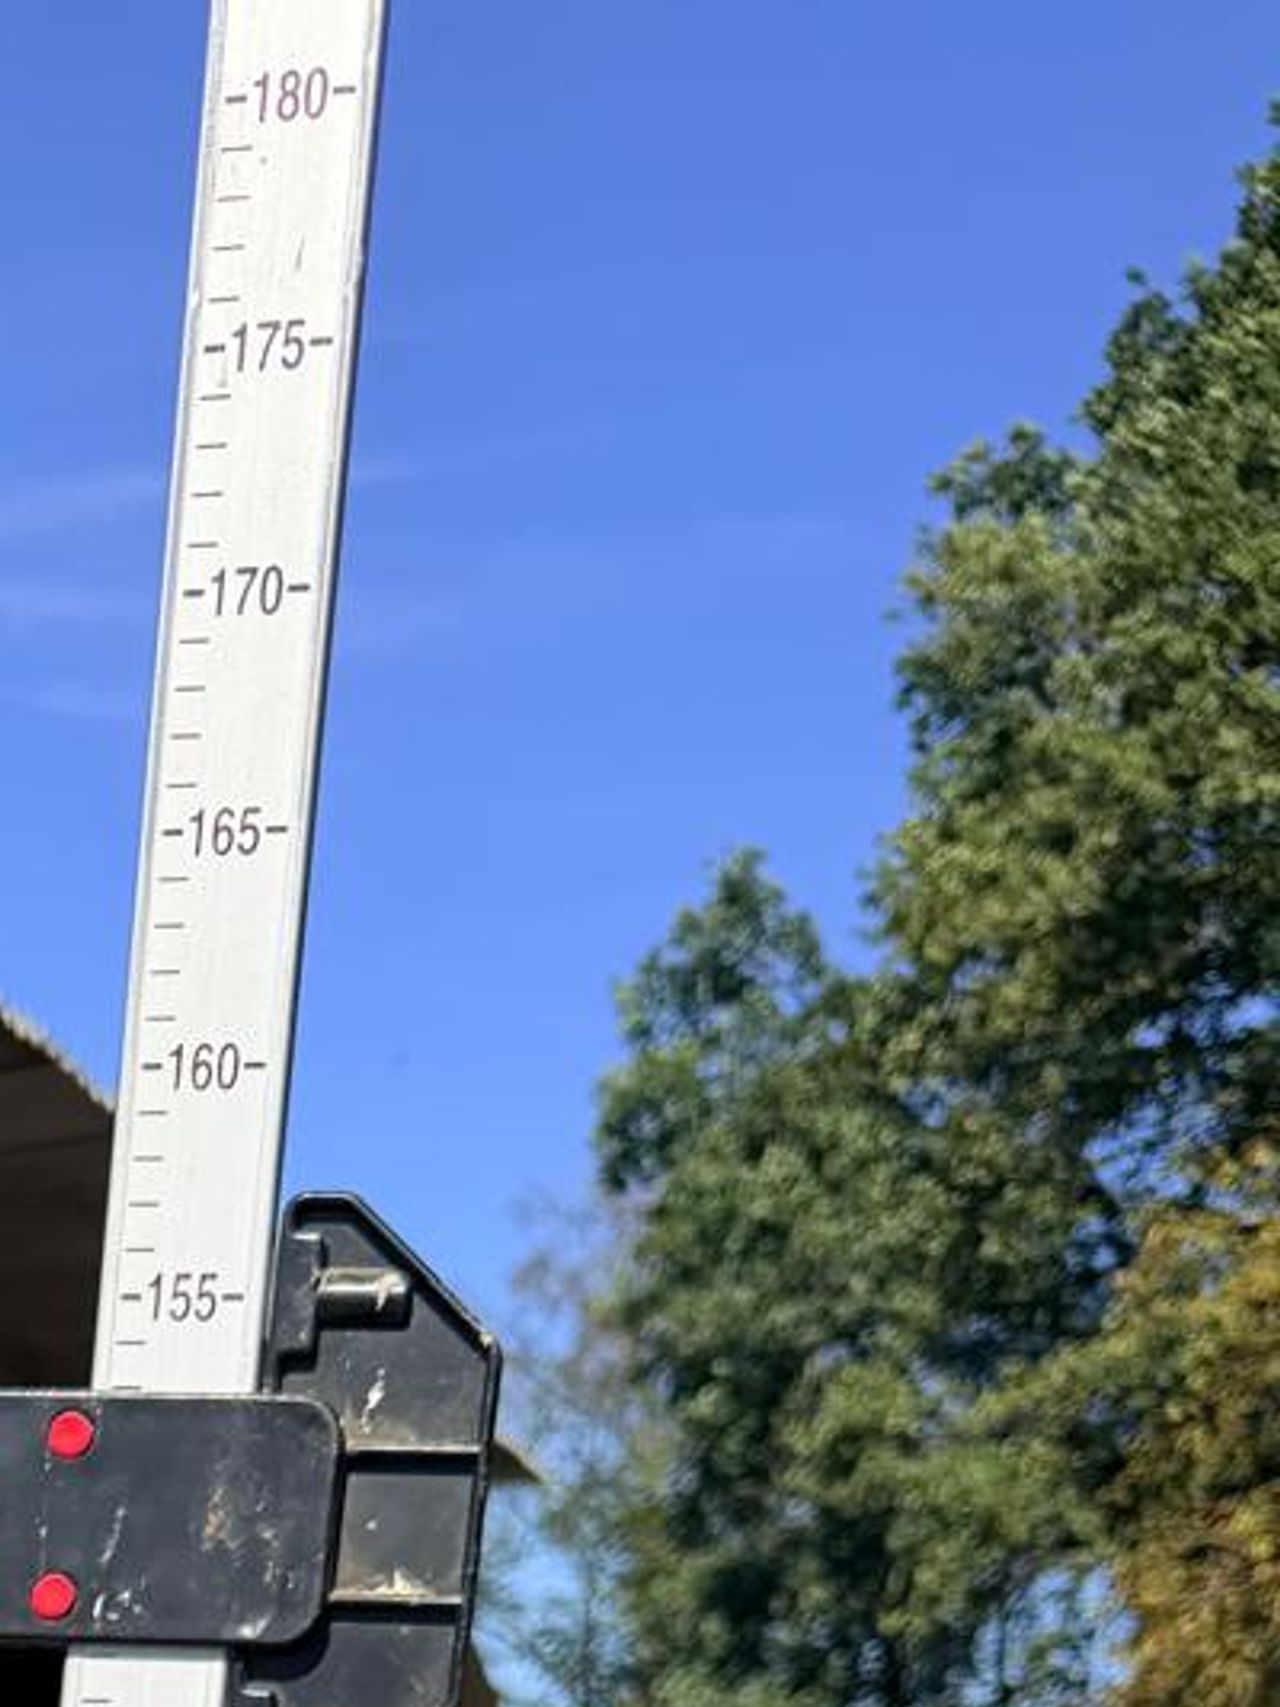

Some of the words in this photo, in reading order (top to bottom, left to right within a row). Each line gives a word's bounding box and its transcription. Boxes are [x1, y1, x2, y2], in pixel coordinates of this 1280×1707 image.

[252, 67, 328, 122] 180
[231, 319, 306, 372] 175
[211, 564, 284, 616] 170
[189, 807, 261, 857] 165
[168, 1042, 239, 1091] 160
[148, 1271, 218, 1322] 155
